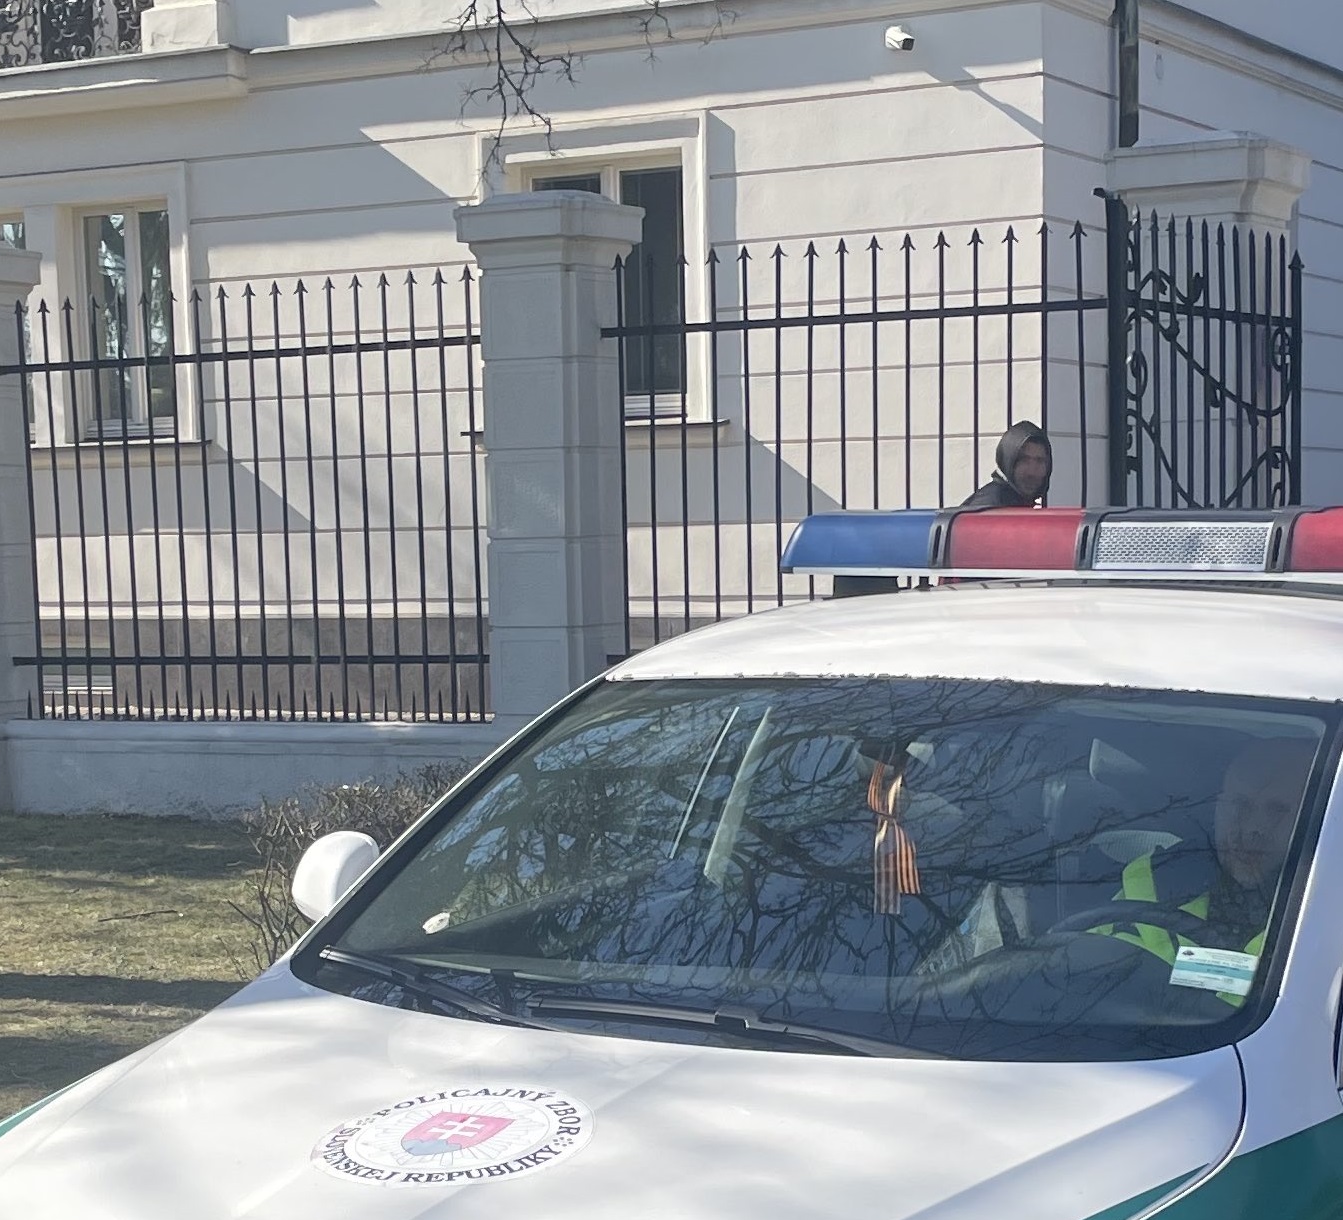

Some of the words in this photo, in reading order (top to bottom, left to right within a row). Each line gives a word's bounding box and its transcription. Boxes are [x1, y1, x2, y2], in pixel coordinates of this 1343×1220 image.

[375, 1087, 557, 1118] POLICAJNÝ
[545, 1100, 581, 1136] ZBOR
[400, 1144, 561, 1183] REPUBLIKY
